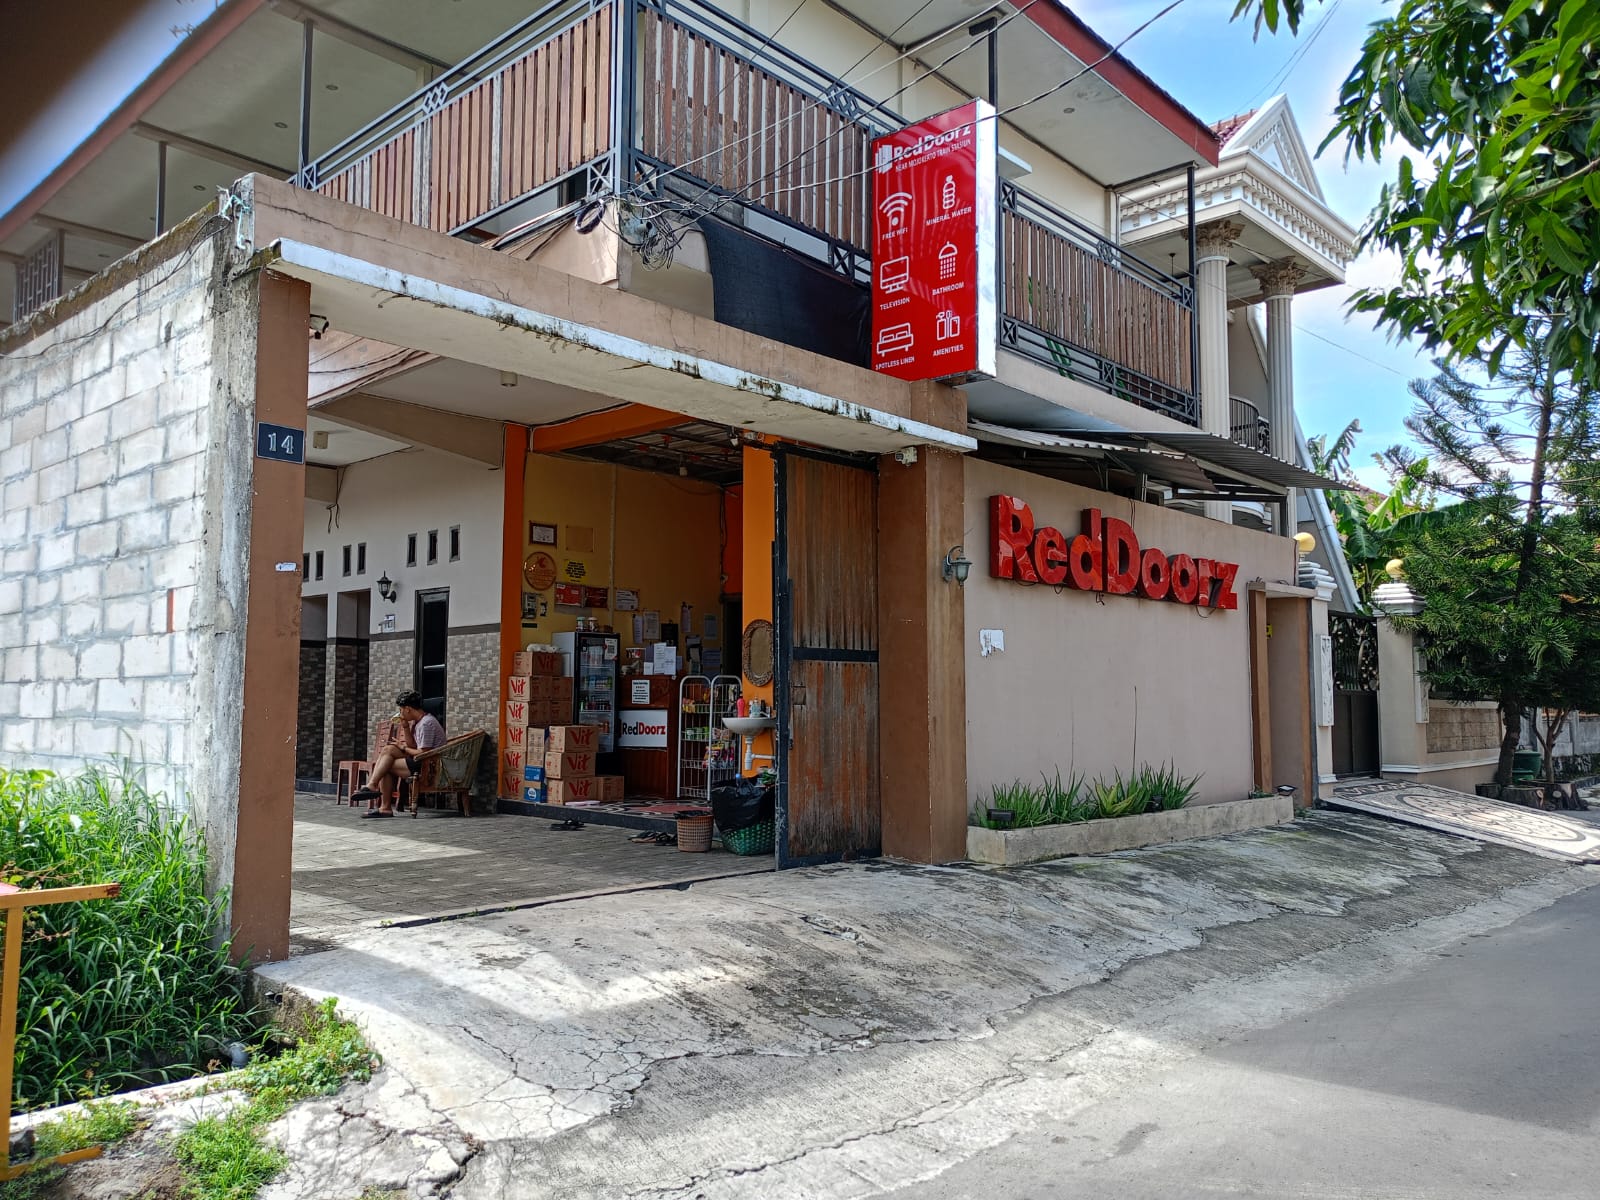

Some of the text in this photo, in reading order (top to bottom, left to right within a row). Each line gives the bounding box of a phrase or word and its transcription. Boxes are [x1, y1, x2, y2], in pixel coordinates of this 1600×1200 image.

[926, 207, 972, 226] MINERAL WATER
[882, 228, 908, 240] FREE WIFI
[932, 282, 964, 296] BATHROOM
[880, 297, 910, 311] TELEVISION
[933, 344, 964, 357] AMENITIES
[901, 356, 915, 366] LINEN
[268, 432, 294, 454] 14
[989, 494, 1240, 610] RedDoorz
[511, 679, 526, 694] Vit
[508, 703, 524, 718] Vit
[508, 727, 523, 743] Vit
[623, 722, 666, 735] RedDoorz
[570, 728, 594, 745] Vit
[506, 752, 522, 768] Vit
[567, 753, 591, 770] Vit
